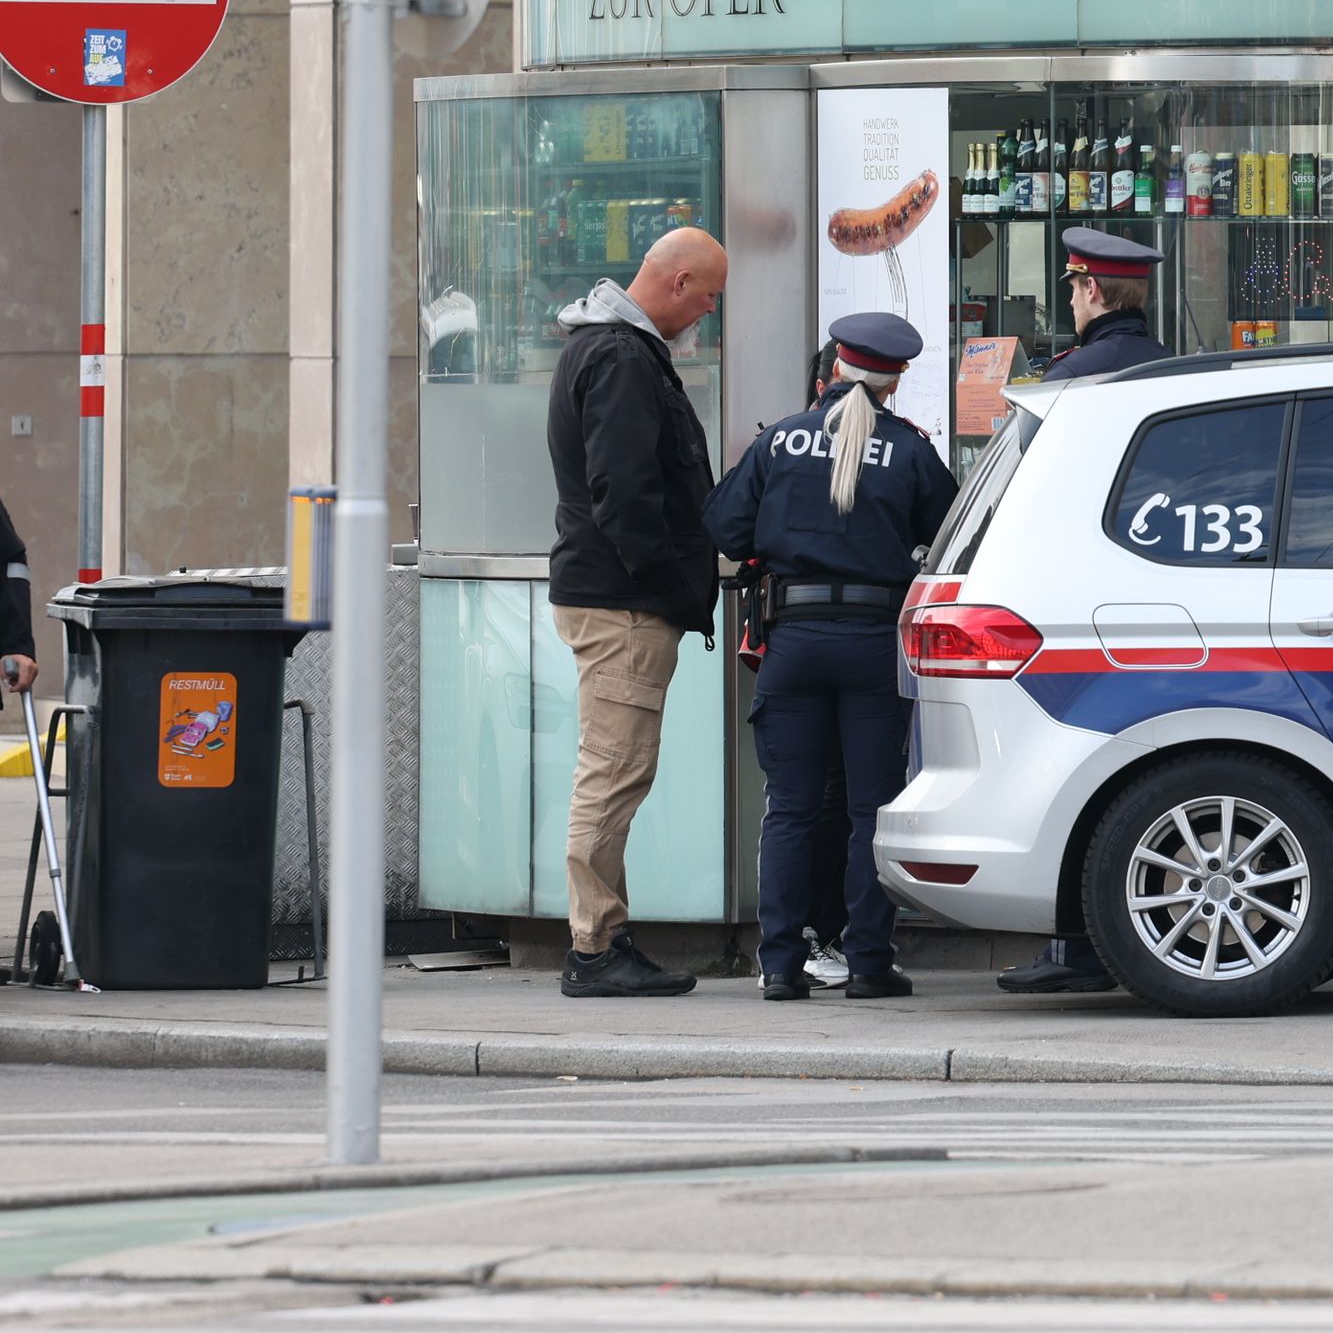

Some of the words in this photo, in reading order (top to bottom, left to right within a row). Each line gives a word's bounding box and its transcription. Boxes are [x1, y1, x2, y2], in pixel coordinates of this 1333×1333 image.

[863, 165, 900, 181] GENUSS
[770, 428, 894, 468] POLIEI
[1175, 504, 1264, 553] 133
